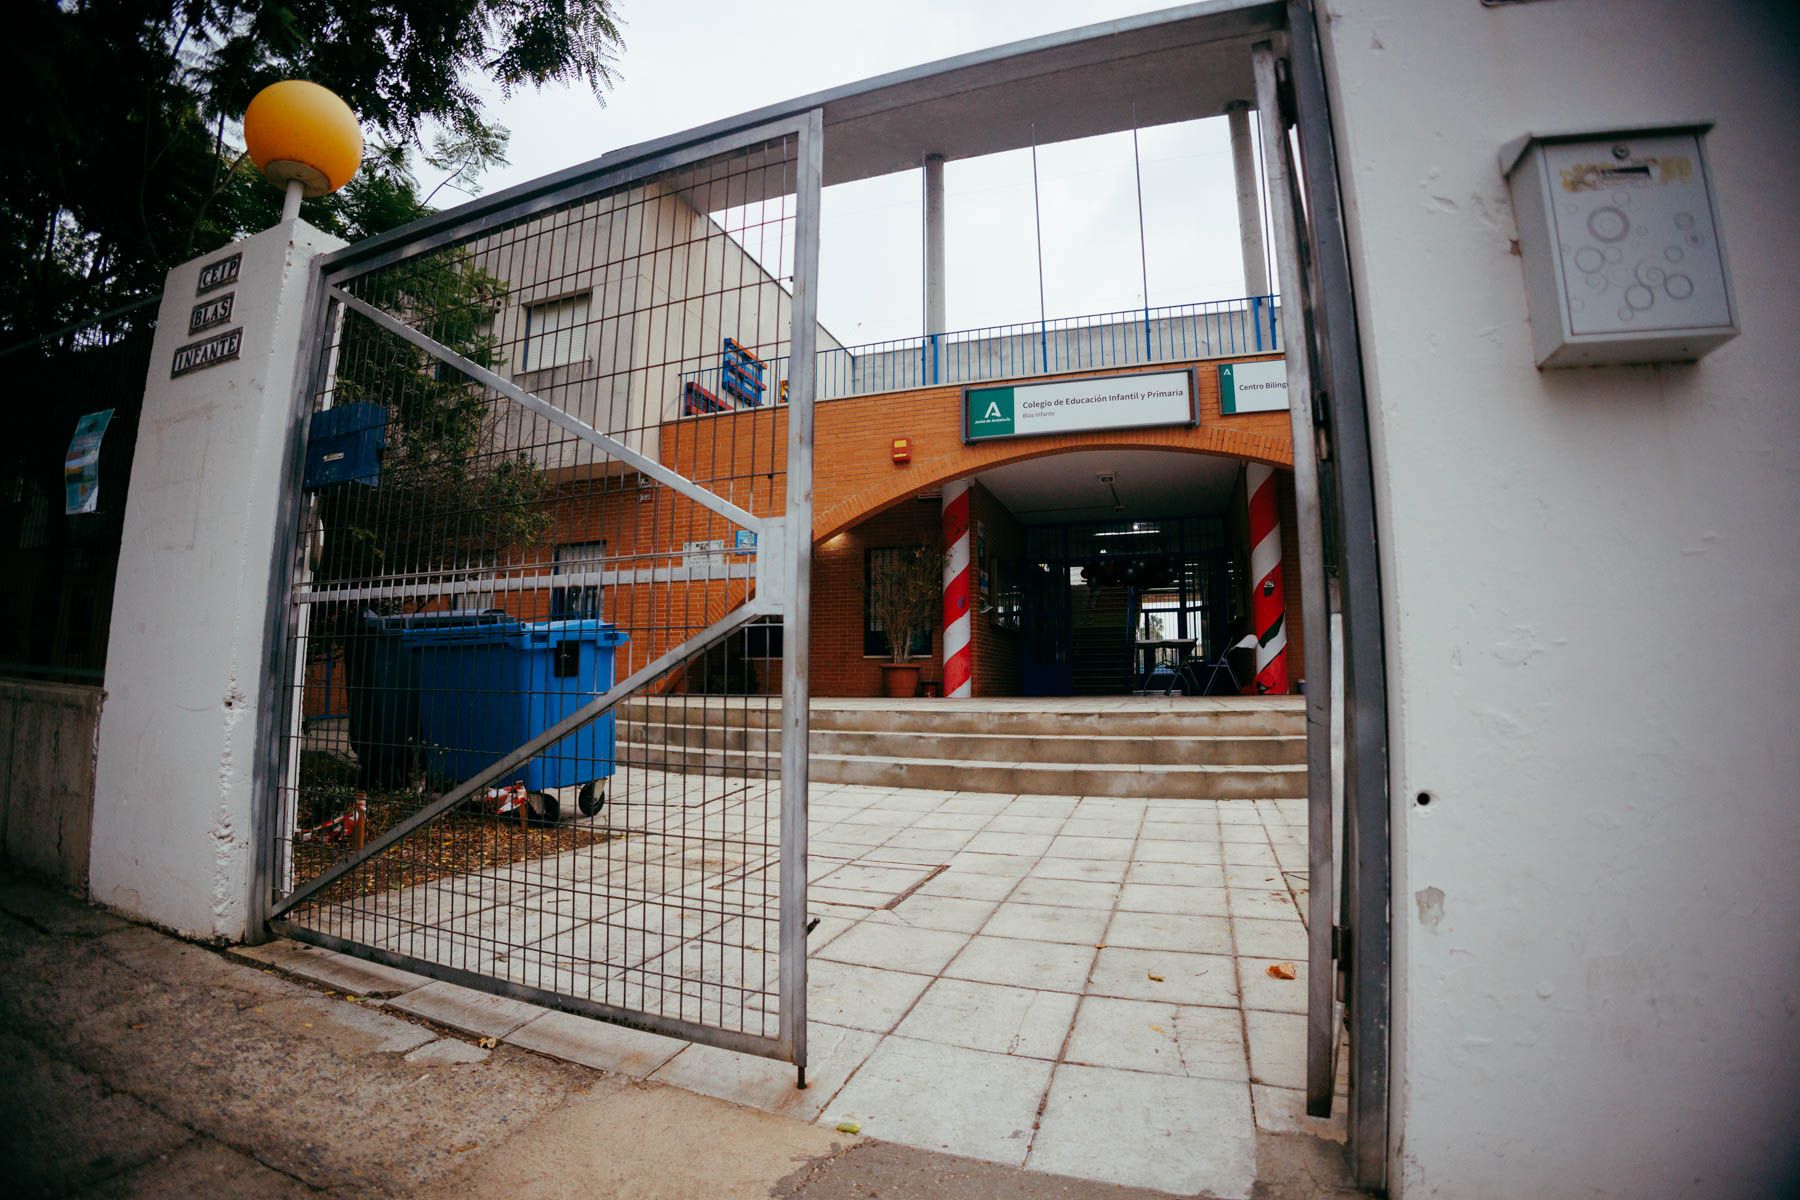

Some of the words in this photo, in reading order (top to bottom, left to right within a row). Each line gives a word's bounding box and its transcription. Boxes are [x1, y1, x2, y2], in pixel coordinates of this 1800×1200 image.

[202, 260, 237, 287] CEIP
[193, 300, 229, 327] BLAS
[177, 335, 237, 370] INFANTE
[1022, 399, 1052, 409] Colegio
[1053, 398, 1064, 406] de
[1065, 394, 1107, 405] Educación
[1109, 392, 1139, 402] Infantil
[1140, 393, 1146, 401] y
[1147, 389, 1184, 399] Primaria
[1035, 410, 1056, 418] Infante
